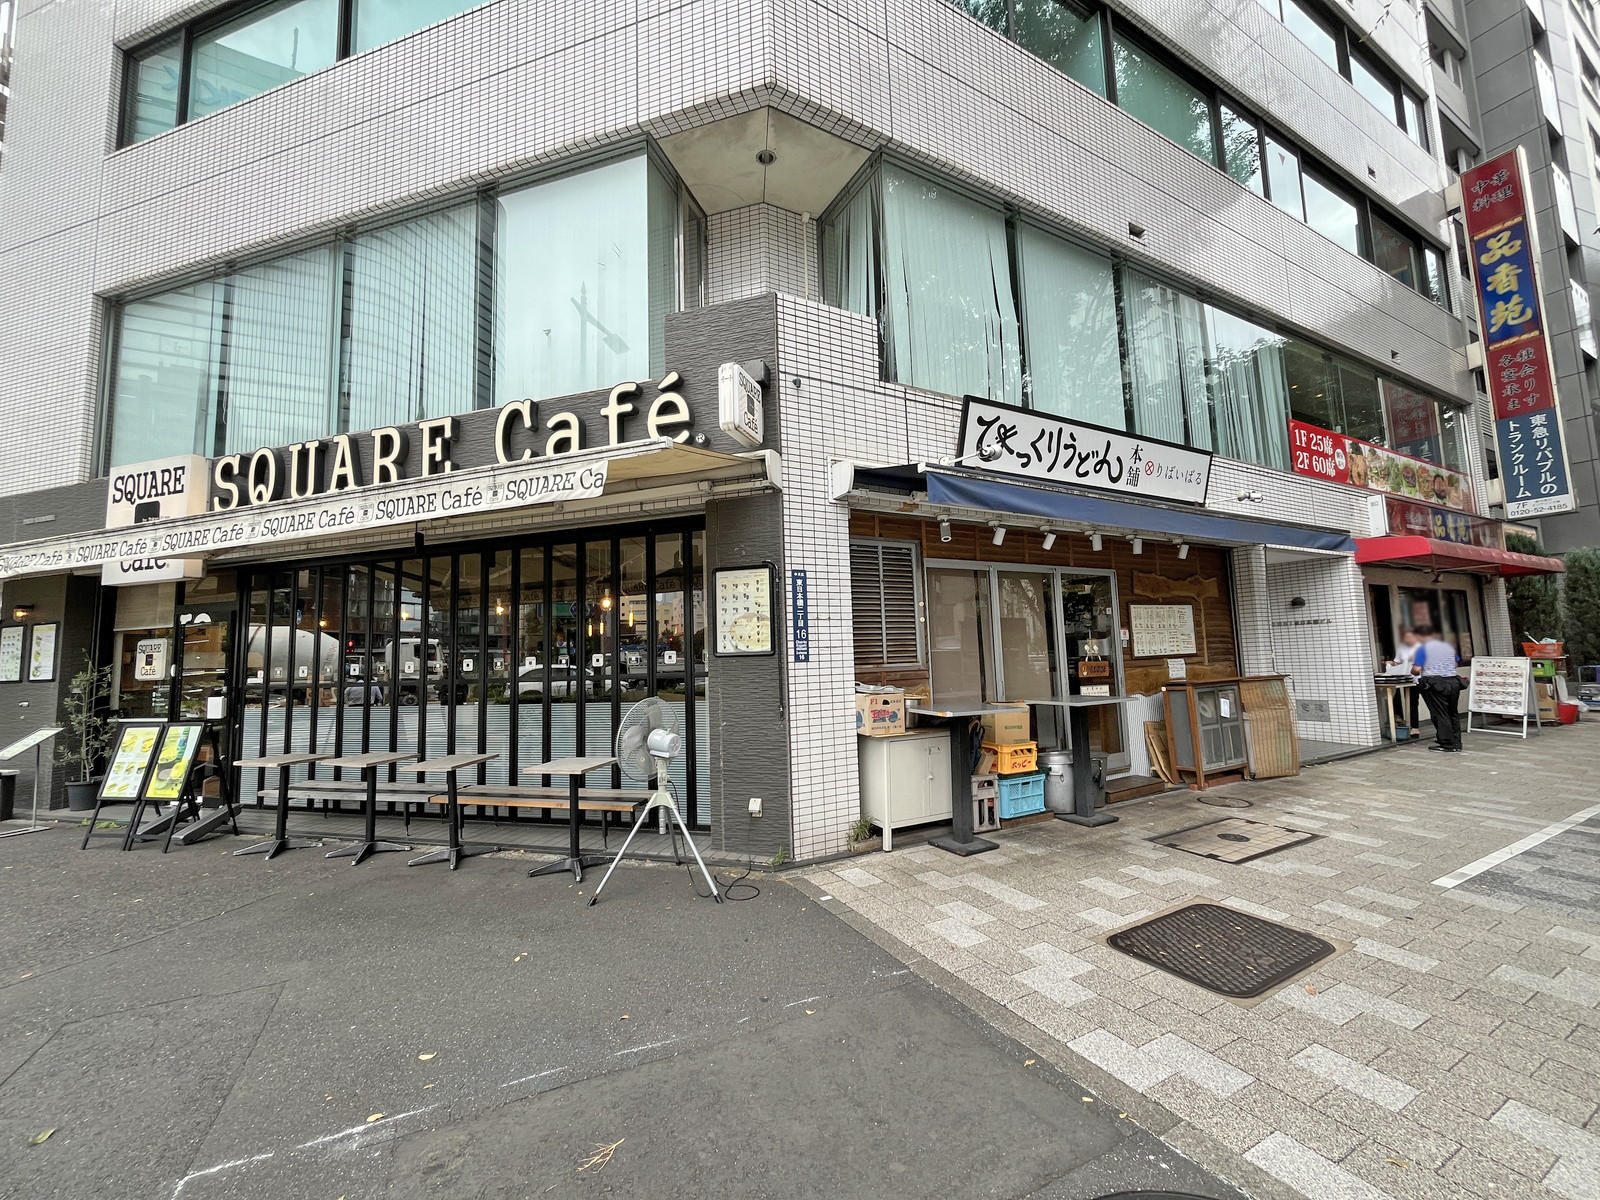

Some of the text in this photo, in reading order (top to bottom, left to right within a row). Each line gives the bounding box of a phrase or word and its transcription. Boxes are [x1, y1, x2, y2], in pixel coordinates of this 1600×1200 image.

[1471, 168, 1510, 194] 中華
[1472, 185, 1513, 212] 料理
[1480, 230, 1533, 333] 品香苑
[1507, 393, 1540, 411] ます
[213, 371, 693, 511] SQUARE Café
[1295, 429, 1333, 455] 1F 25席
[1529, 413, 1558, 495] 東急リバブルの
[1126, 444, 1142, 488] 本舗
[1156, 463, 1202, 485] りばいばる
[1296, 451, 1309, 469] 2F
[1312, 455, 1336, 477] 60席
[1508, 420, 1531, 499] トランクルーム
[113, 466, 186, 505] SQUARE
[76, 542, 118, 564] SQUARE
[120, 538, 147, 556] Café
[162, 528, 210, 551] SQUARE
[212, 525, 243, 542] Café
[261, 512, 316, 537] SQUARE
[318, 506, 355, 528] Café
[375, 493, 437, 520] SQUARE
[441, 486, 482, 511] Café
[505, 471, 577, 501] SQUARE
[1516, 501, 1528, 509] 7F
[796, 629, 807, 639] 16
[138, 644, 162, 655] SQUARE
[140, 666, 157, 676] Café
